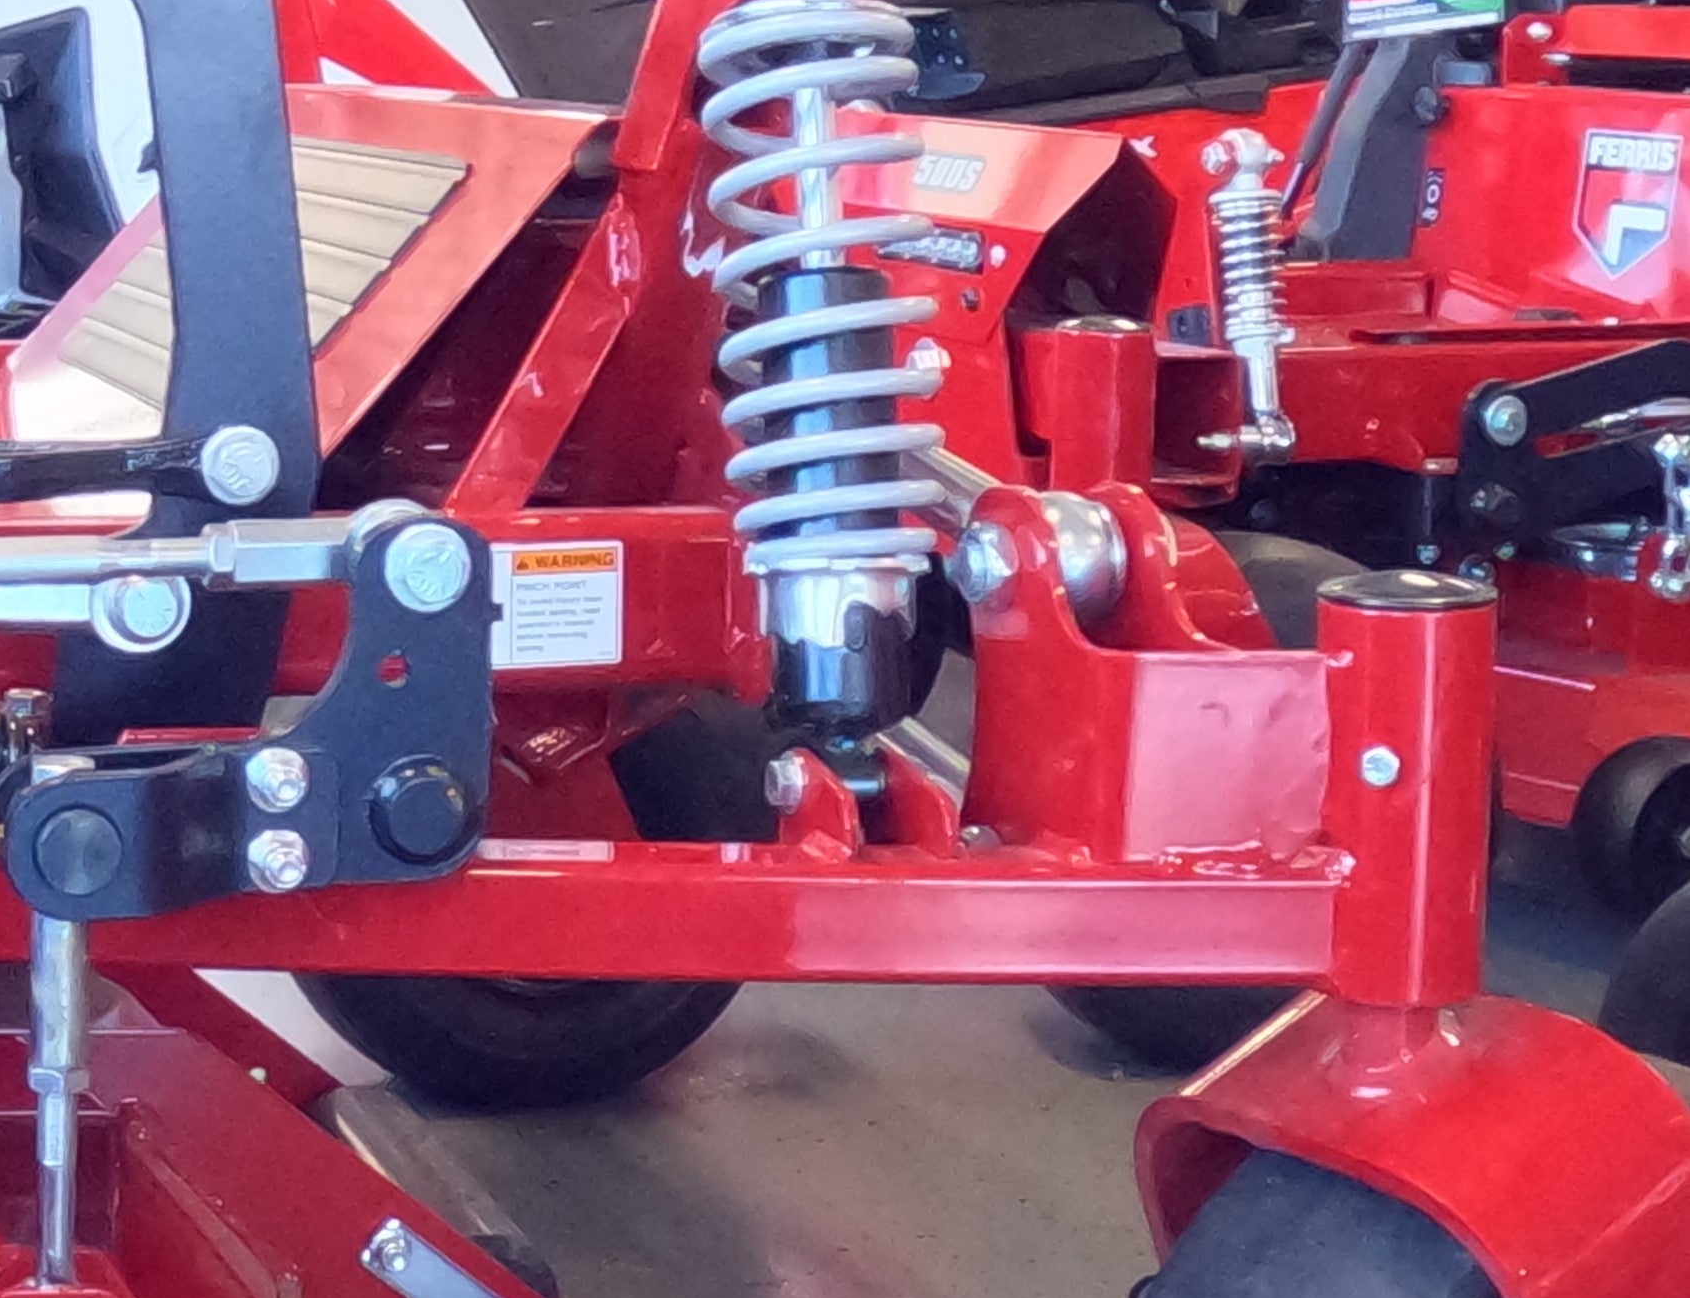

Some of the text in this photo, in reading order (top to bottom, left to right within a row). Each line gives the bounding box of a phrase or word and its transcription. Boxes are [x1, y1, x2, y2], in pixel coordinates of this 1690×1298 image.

[1588, 136, 1677, 171] FERRIS
[913, 153, 985, 191] 500S
[535, 551, 614, 568] WARNING
